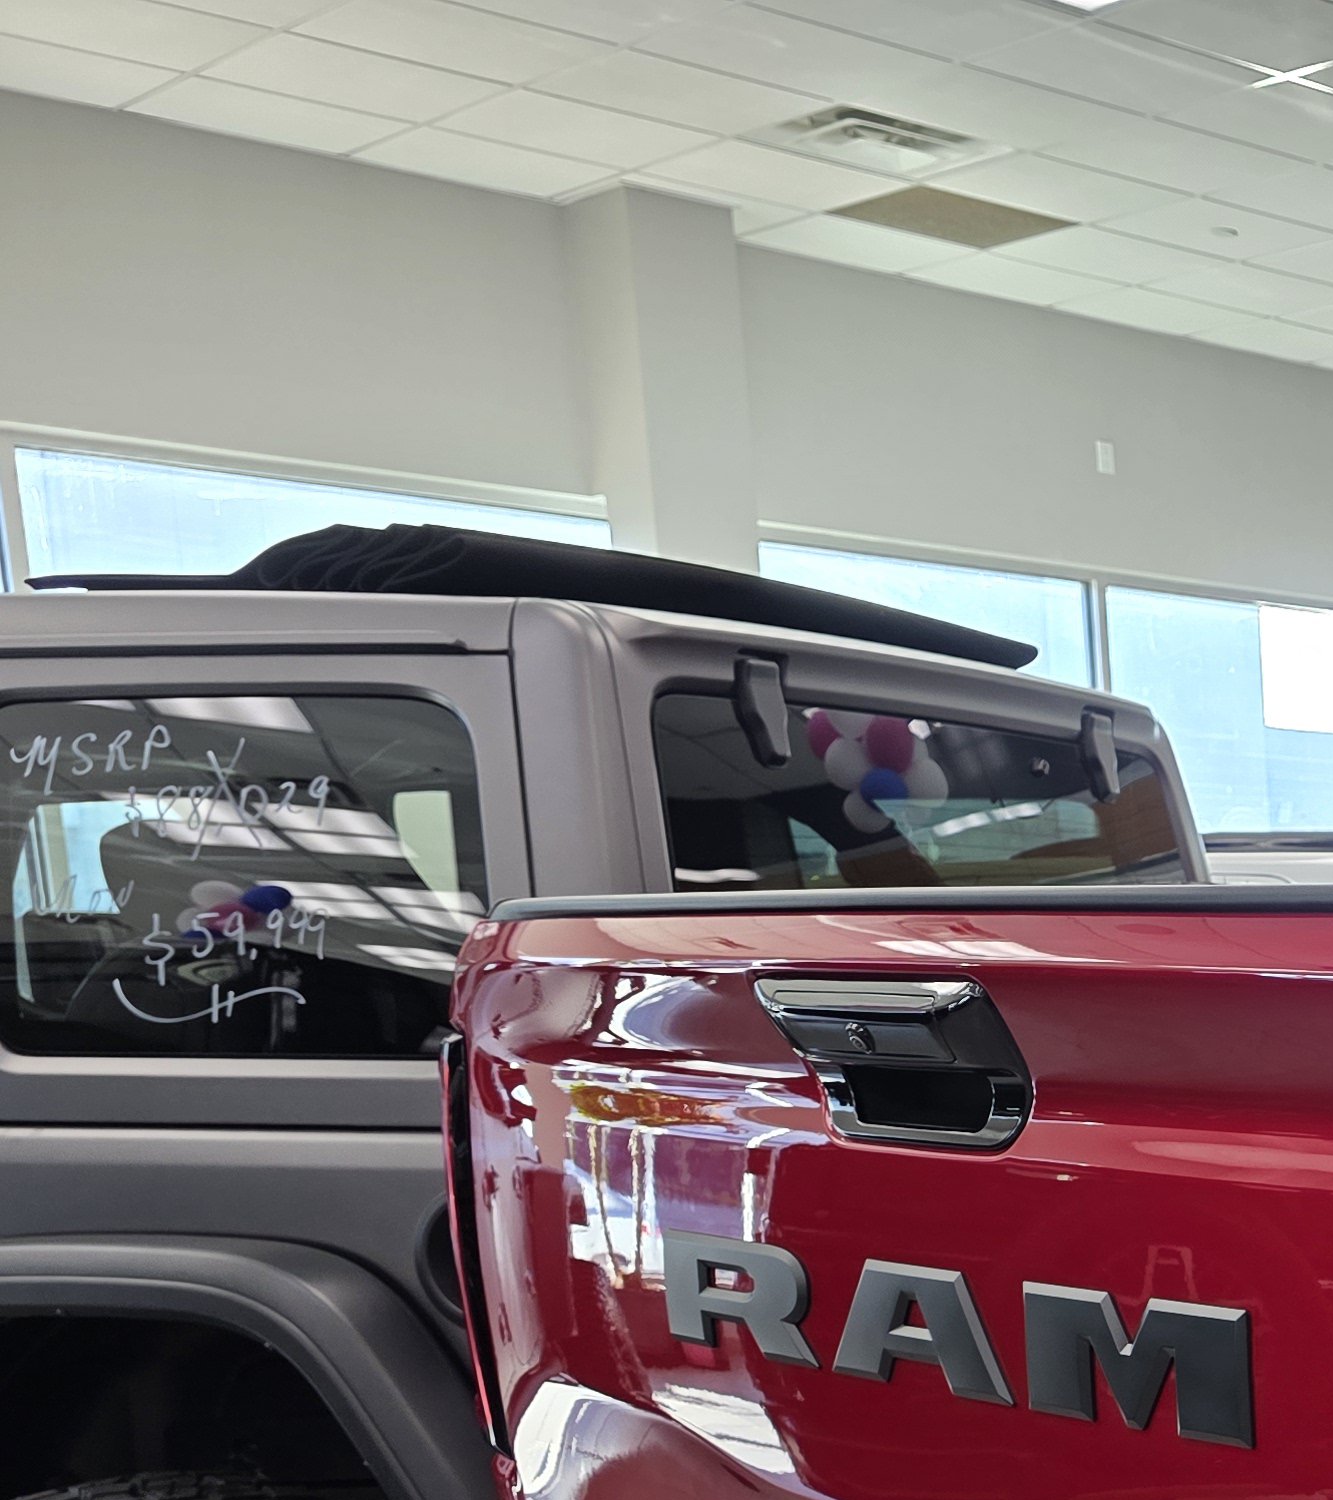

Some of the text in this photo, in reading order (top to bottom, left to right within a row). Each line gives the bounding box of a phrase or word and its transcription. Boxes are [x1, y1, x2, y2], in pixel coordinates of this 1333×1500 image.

[10, 724, 171, 795] MSRP
[142, 908, 330, 986] $59,999
[661, 1228, 1256, 1450] RAM
